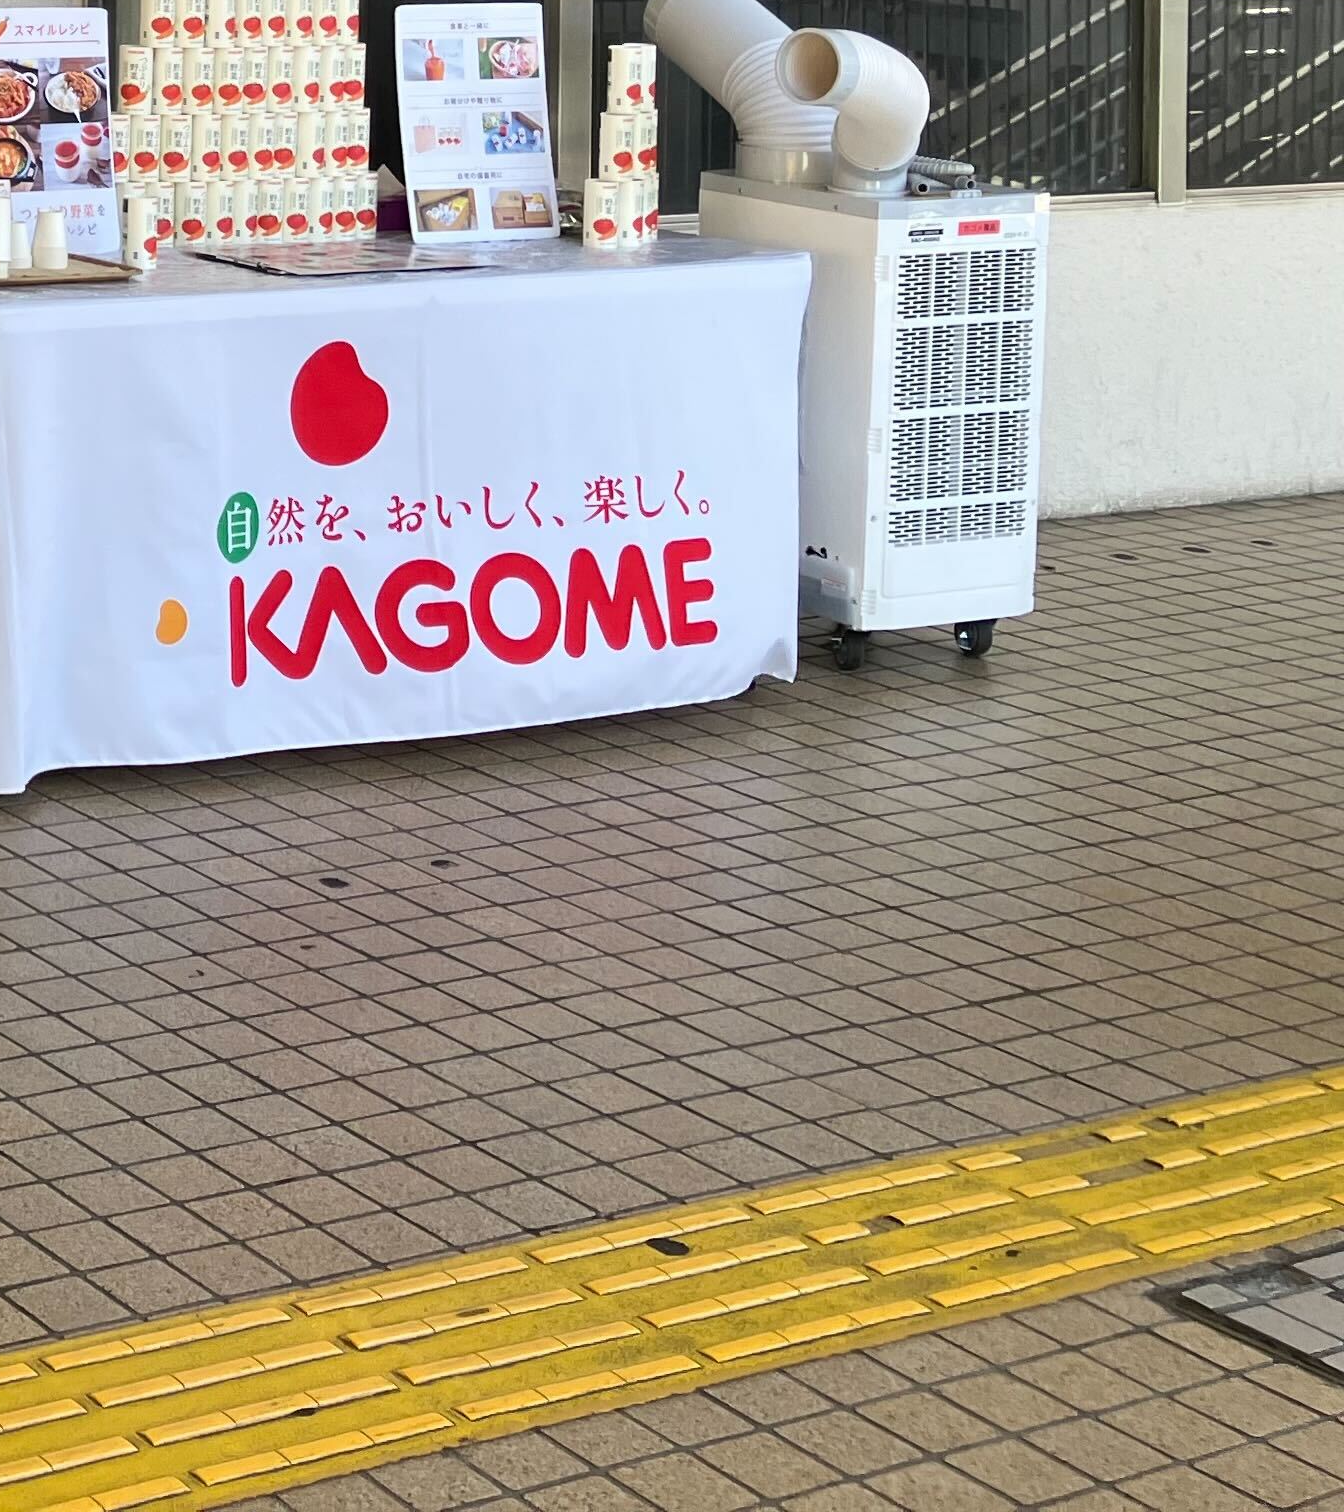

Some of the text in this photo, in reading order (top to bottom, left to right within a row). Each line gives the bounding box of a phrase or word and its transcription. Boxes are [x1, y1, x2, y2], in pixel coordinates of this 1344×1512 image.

[14, 22, 90, 37] スマイルレシピ
[220, 469, 711, 558] 自然を、おいしく、楽しく。
[228, 537, 719, 688] KAGOME
